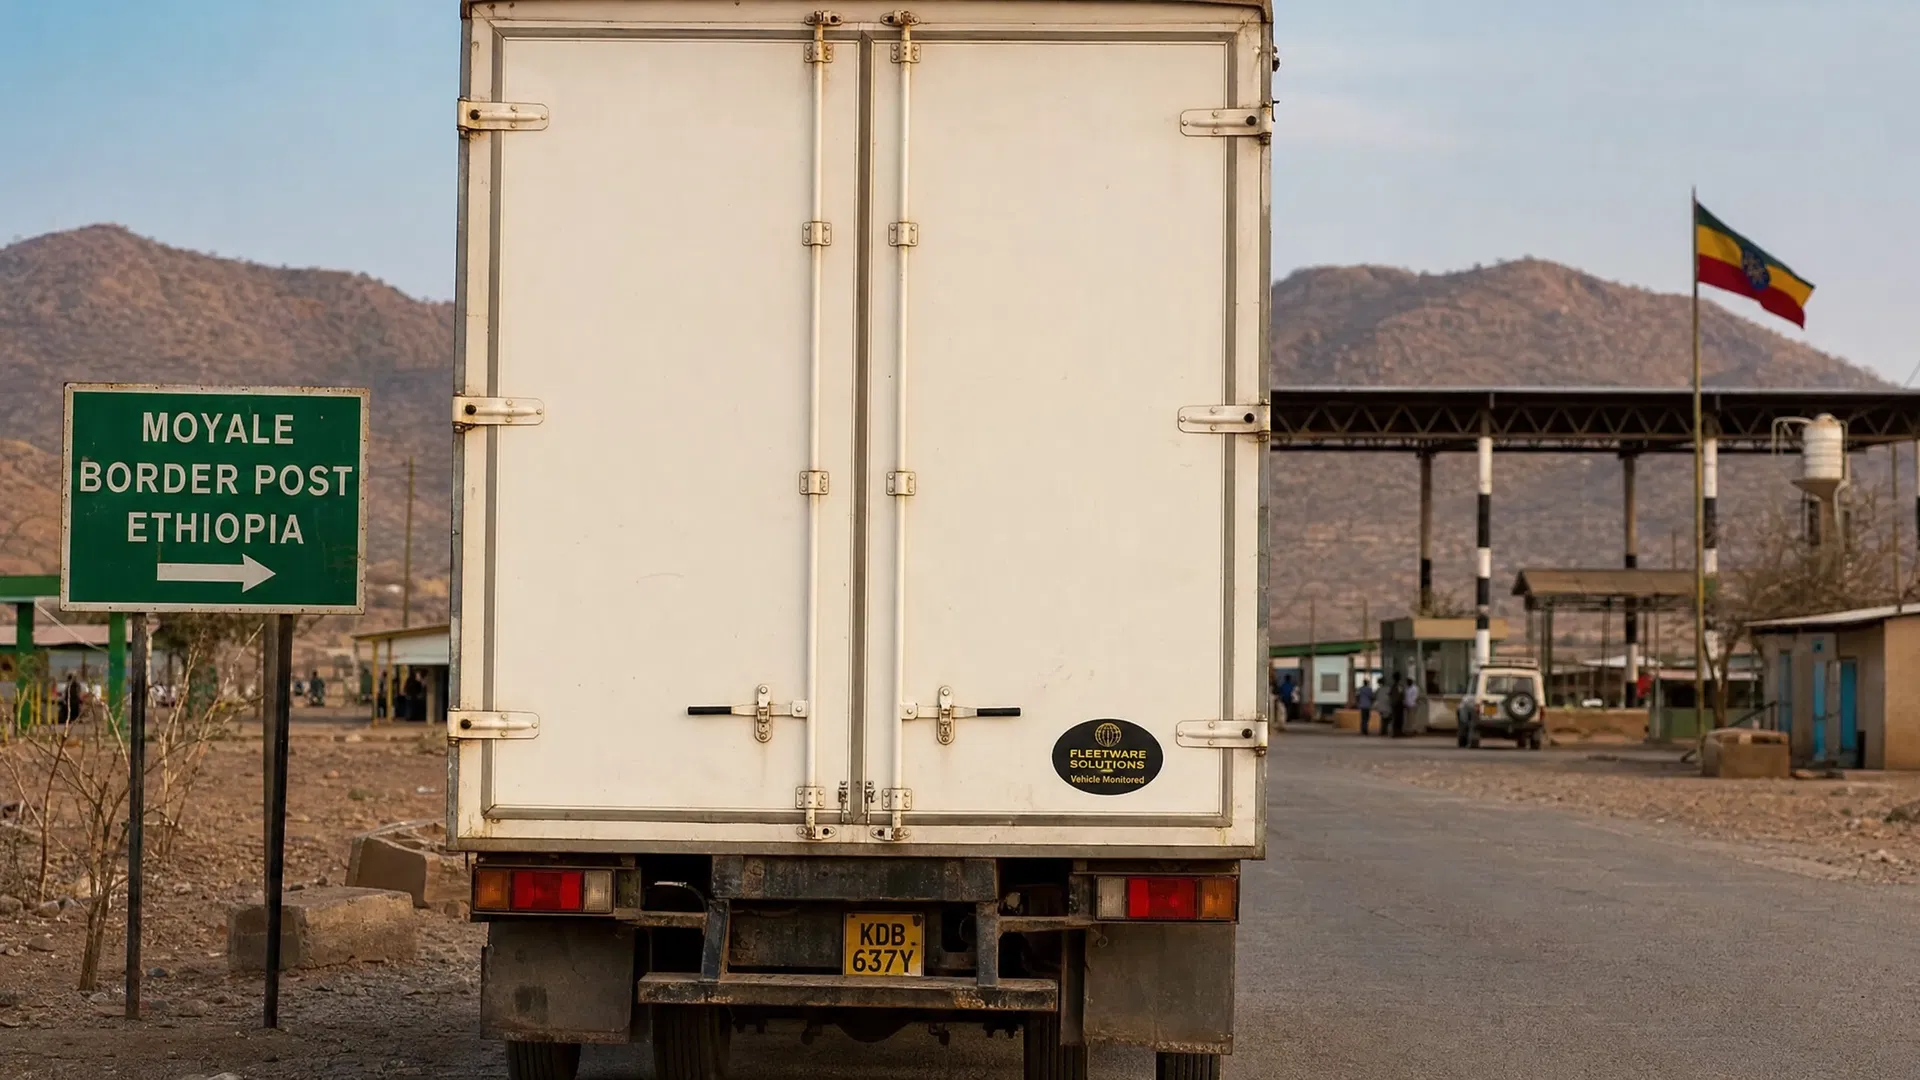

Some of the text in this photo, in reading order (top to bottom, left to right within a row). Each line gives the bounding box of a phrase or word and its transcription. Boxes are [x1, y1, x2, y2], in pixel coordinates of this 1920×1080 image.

[143, 412, 294, 445] MOYALE
[80, 461, 353, 496] BORDER POST
[127, 512, 304, 545] ETHIOPIA
[1069, 749, 1147, 759] FLEETWARE
[1069, 760, 1145, 770] SOLUTIONS
[1070, 775, 1145, 784] Vehicle Monitored
[860, 922, 906, 946] KDB
[852, 948, 914, 973] 637Y
